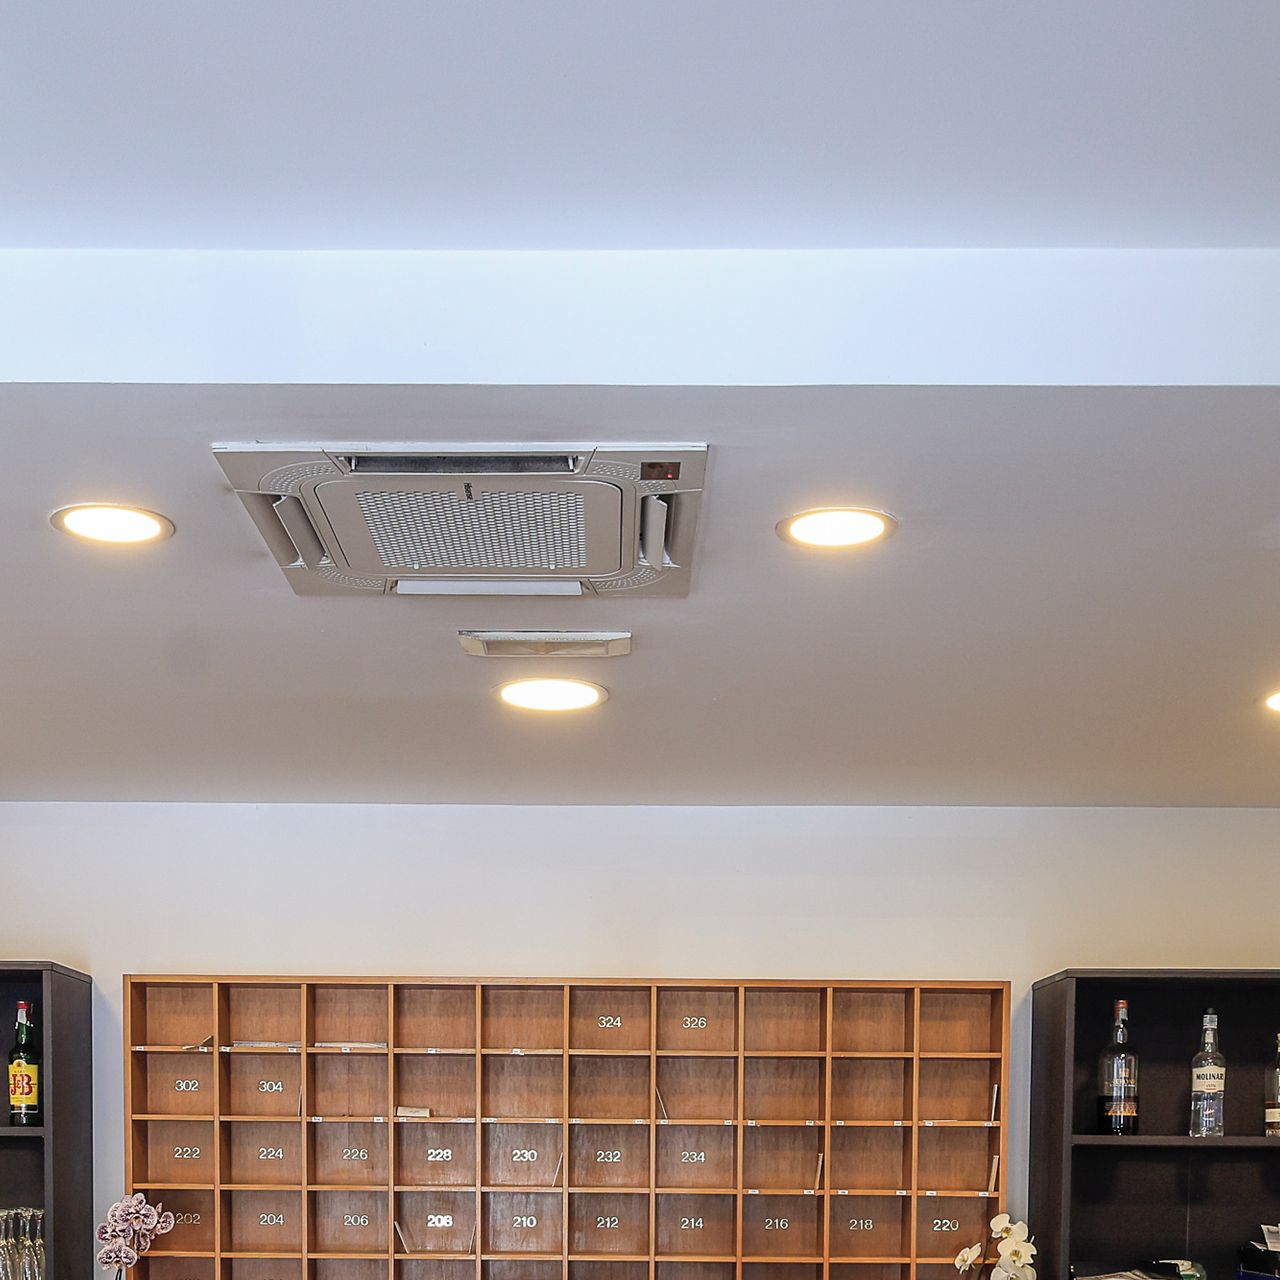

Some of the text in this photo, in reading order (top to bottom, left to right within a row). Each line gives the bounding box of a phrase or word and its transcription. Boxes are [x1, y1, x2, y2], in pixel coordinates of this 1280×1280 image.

[598, 1017, 622, 1029] 324
[682, 1017, 707, 1029] 326
[10, 1074, 33, 1096] J&B
[175, 1079, 199, 1092] 302
[258, 1080, 283, 1092] 304
[174, 1147, 200, 1159] 222
[258, 1147, 284, 1160] 224
[342, 1148, 368, 1160] 226
[426, 1149, 452, 1162] 228
[512, 1149, 538, 1162] 230
[596, 1150, 621, 1163] 232
[680, 1151, 706, 1164] 234
[175, 1213, 201, 1225] 202
[259, 1213, 284, 1226] 204
[343, 1214, 369, 1226] 206
[426, 1214, 454, 1227] 208
[512, 1215, 537, 1228] 210
[596, 1216, 619, 1229] 212
[680, 1217, 704, 1230] 214
[764, 1218, 789, 1230] 216
[849, 1218, 874, 1231] 218
[933, 1219, 960, 1232] 220
